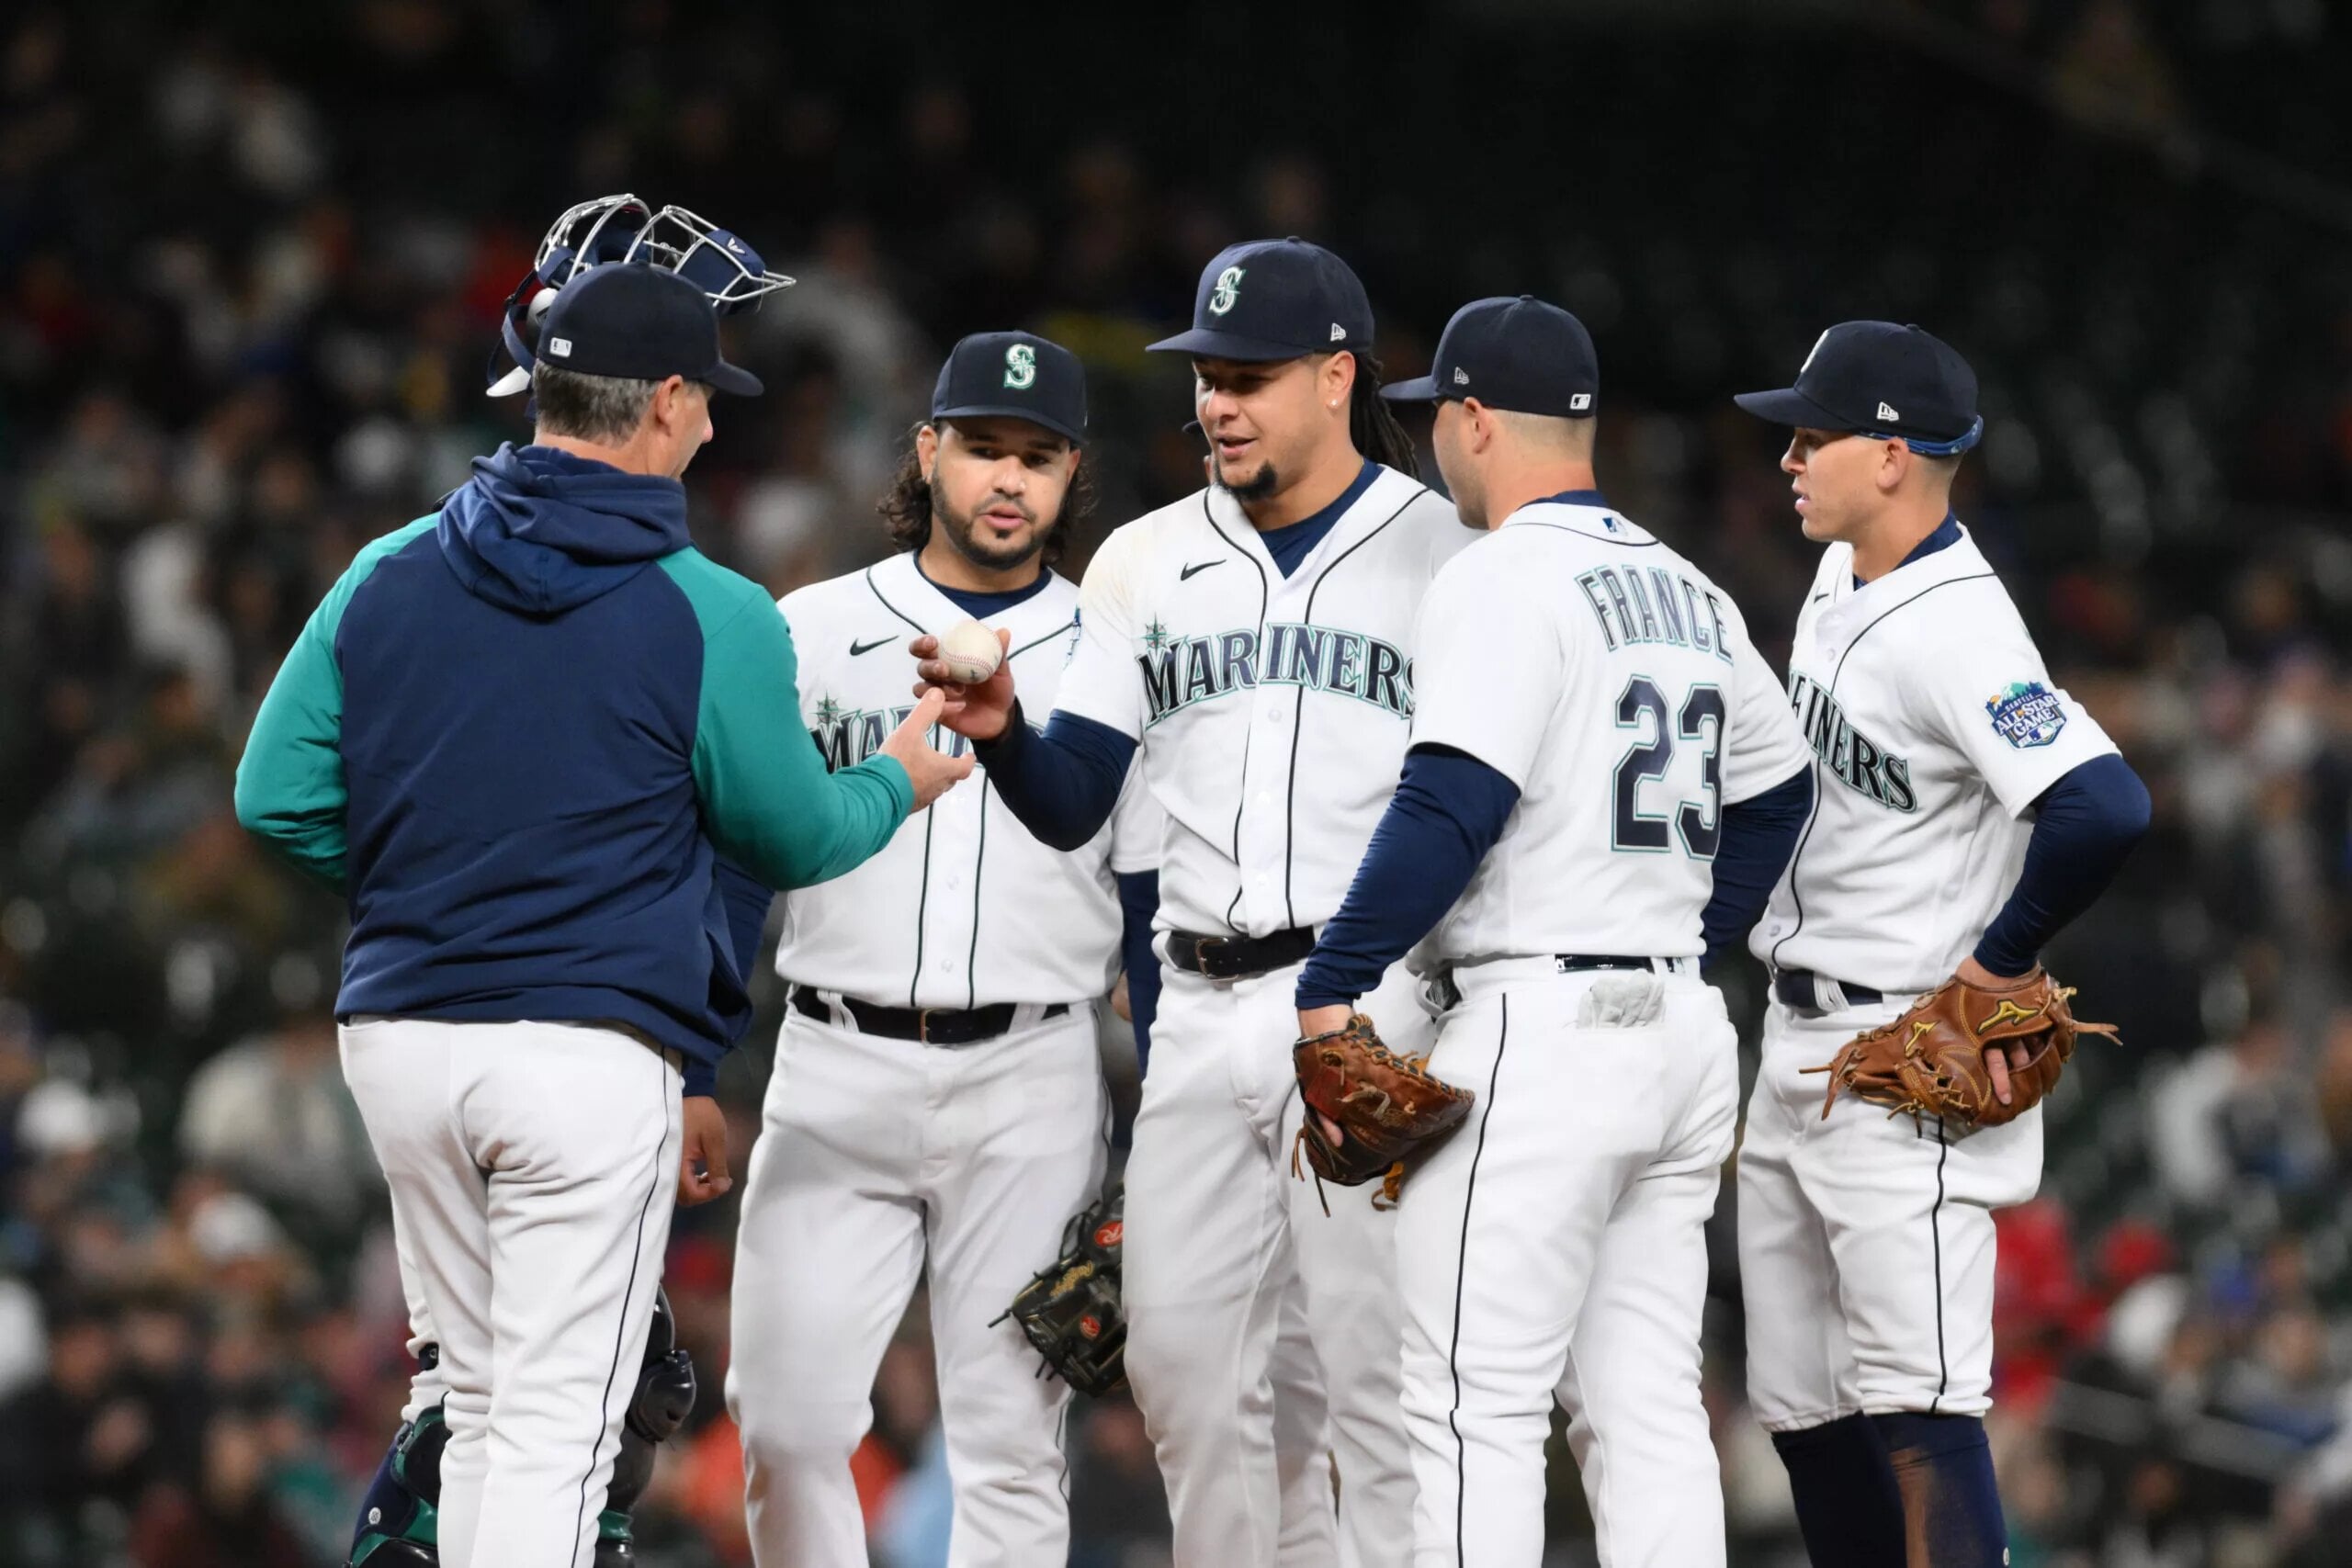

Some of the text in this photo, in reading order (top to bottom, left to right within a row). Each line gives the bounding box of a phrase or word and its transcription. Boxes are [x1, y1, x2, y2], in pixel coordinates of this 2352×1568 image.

[1208, 265, 1247, 316] S
[1004, 343, 1036, 389] S
[1574, 564, 1735, 668] FRANCE
[2013, 707, 2055, 737] GAME
[1611, 673, 1727, 862] 23
